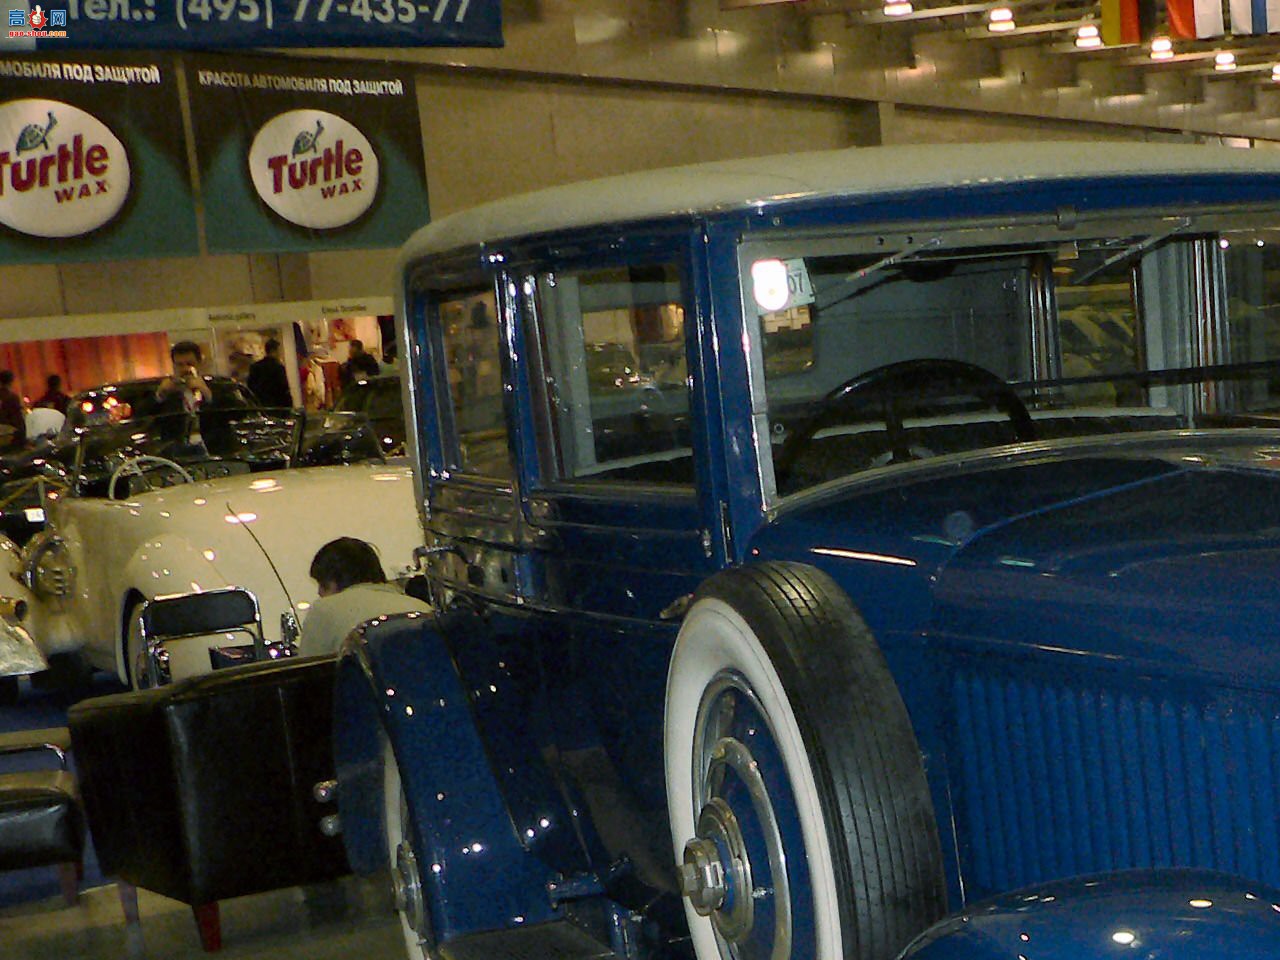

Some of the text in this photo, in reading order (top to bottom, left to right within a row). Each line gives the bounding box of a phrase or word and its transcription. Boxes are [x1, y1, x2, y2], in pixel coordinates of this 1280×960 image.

[63, 63, 94, 83] ПОД
[94, 64, 161, 84] ЗАЩИТОЙ
[198, 70, 251, 88] КРАСОТА
[328, 78, 353, 96] ПОД
[353, 79, 403, 96] ЗАЩИТОЙ
[267, 137, 363, 195] Turtle
[54, 180, 109, 204] WAX
[321, 178, 363, 199] WAX
